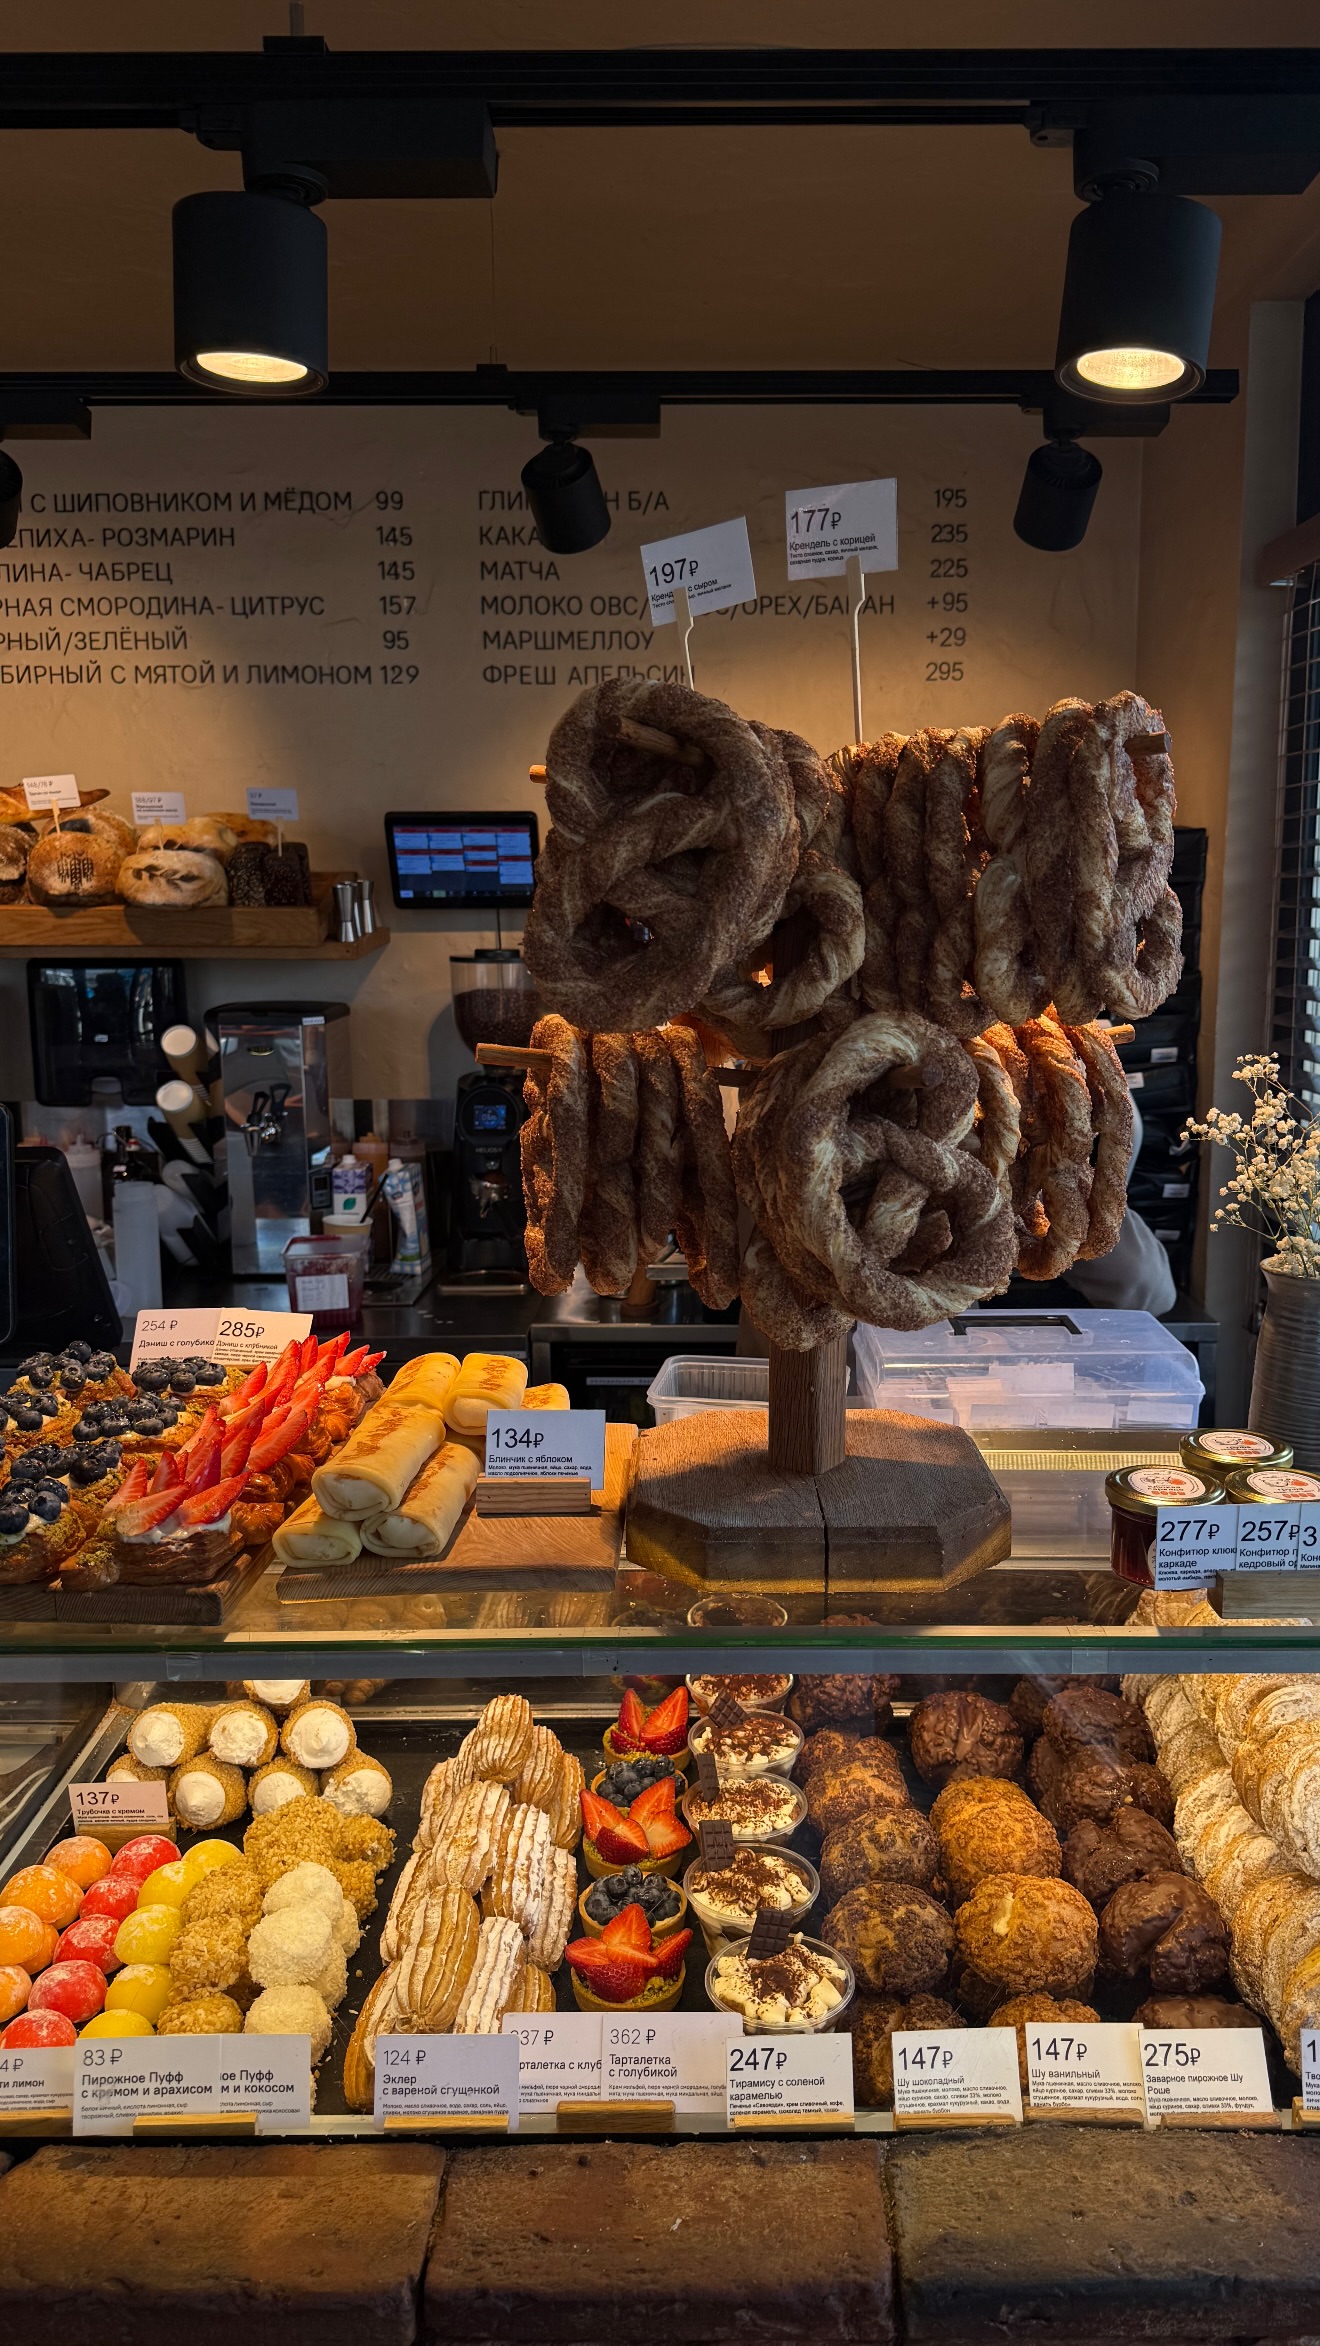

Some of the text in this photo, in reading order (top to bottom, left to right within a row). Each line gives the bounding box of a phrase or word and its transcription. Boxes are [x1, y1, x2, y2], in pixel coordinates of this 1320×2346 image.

[31, 493, 46, 513] С
[54, 491, 233, 513] ШИПОВНИКОМ
[240, 491, 256, 511] И
[264, 487, 352, 514] МЁДОМ
[375, 490, 404, 511] 99
[628, 490, 670, 516] Б/А
[934, 488, 968, 509] 195
[7, 526, 413, 548] ПИХА- РОЗМАРИН 145
[930, 523, 968, 544] 235
[789, 540, 830, 553] Крендель
[840, 533, 876, 547] корицей
[79, 561, 173, 585] ЧАБРЕЦ
[377, 560, 415, 581] 145
[480, 558, 968, 581] МАТЧА 225
[651, 591, 674, 603] Кренд
[693, 579, 718, 591] сыром
[0, 597, 52, 617] НАЯ
[231, 595, 325, 618] ЦИТРУС
[379, 595, 417, 616] 157
[481, 595, 583, 616] МОЛОКО
[927, 592, 968, 612] +95
[383, 630, 409, 650] 95
[482, 627, 966, 650] МАРШМЕЛЛОУ +29
[1, 660, 419, 685] БИРНЫЙ С МЯТОЙ И ЛИМОНОМ 129
[483, 665, 555, 685] ФРЕШ
[926, 662, 964, 681] 295
[141, 1320, 166, 1332] 254
[138, 1339, 168, 1348] Дэниш
[176, 1338, 215, 1348] голубико
[216, 1340, 238, 1348] Дэниш
[488, 1454, 526, 1463] Блинчик
[535, 1454, 573, 1463] яблоком
[1159, 1548, 1210, 1557] Конфитюр
[1239, 1547, 1290, 1558] Конфитюр
[1158, 1560, 1197, 1569] каркаде
[1238, 1558, 1286, 1569] кедровый
[77, 1808, 110, 1816] Трубочка
[510, 2029, 540, 2046] 37
[610, 2028, 641, 2045] 362
[83, 2049, 105, 2067] 83
[383, 2050, 411, 2066] 124
[609, 2053, 671, 2069] Тарталетка
[568, 2062, 575, 2070] с
[609, 2065, 678, 2080] с голубикой
[81, 2071, 184, 2087] Пирожное Пуфф
[220, 2069, 274, 2083] ое Пуфф
[383, 2074, 417, 2086] Эклер
[897, 2075, 965, 2088] Шу шоколадный
[1031, 2069, 1101, 2081] Шу ванильный
[1146, 2073, 1243, 2085] Заварное пирожное Шу
[12, 2079, 45, 2088] лимон
[233, 2084, 241, 2093] и
[244, 2083, 295, 2094] кокосом
[382, 2083, 500, 2097] с вареной сгущенкой
[729, 2076, 825, 2090] Тирамису с соленой
[81, 2089, 89, 2099] с
[143, 2086, 150, 2096] и
[153, 2085, 213, 2097] арахисом
[729, 2091, 783, 2102] карамелью
[1147, 2086, 1171, 2095] Роше
